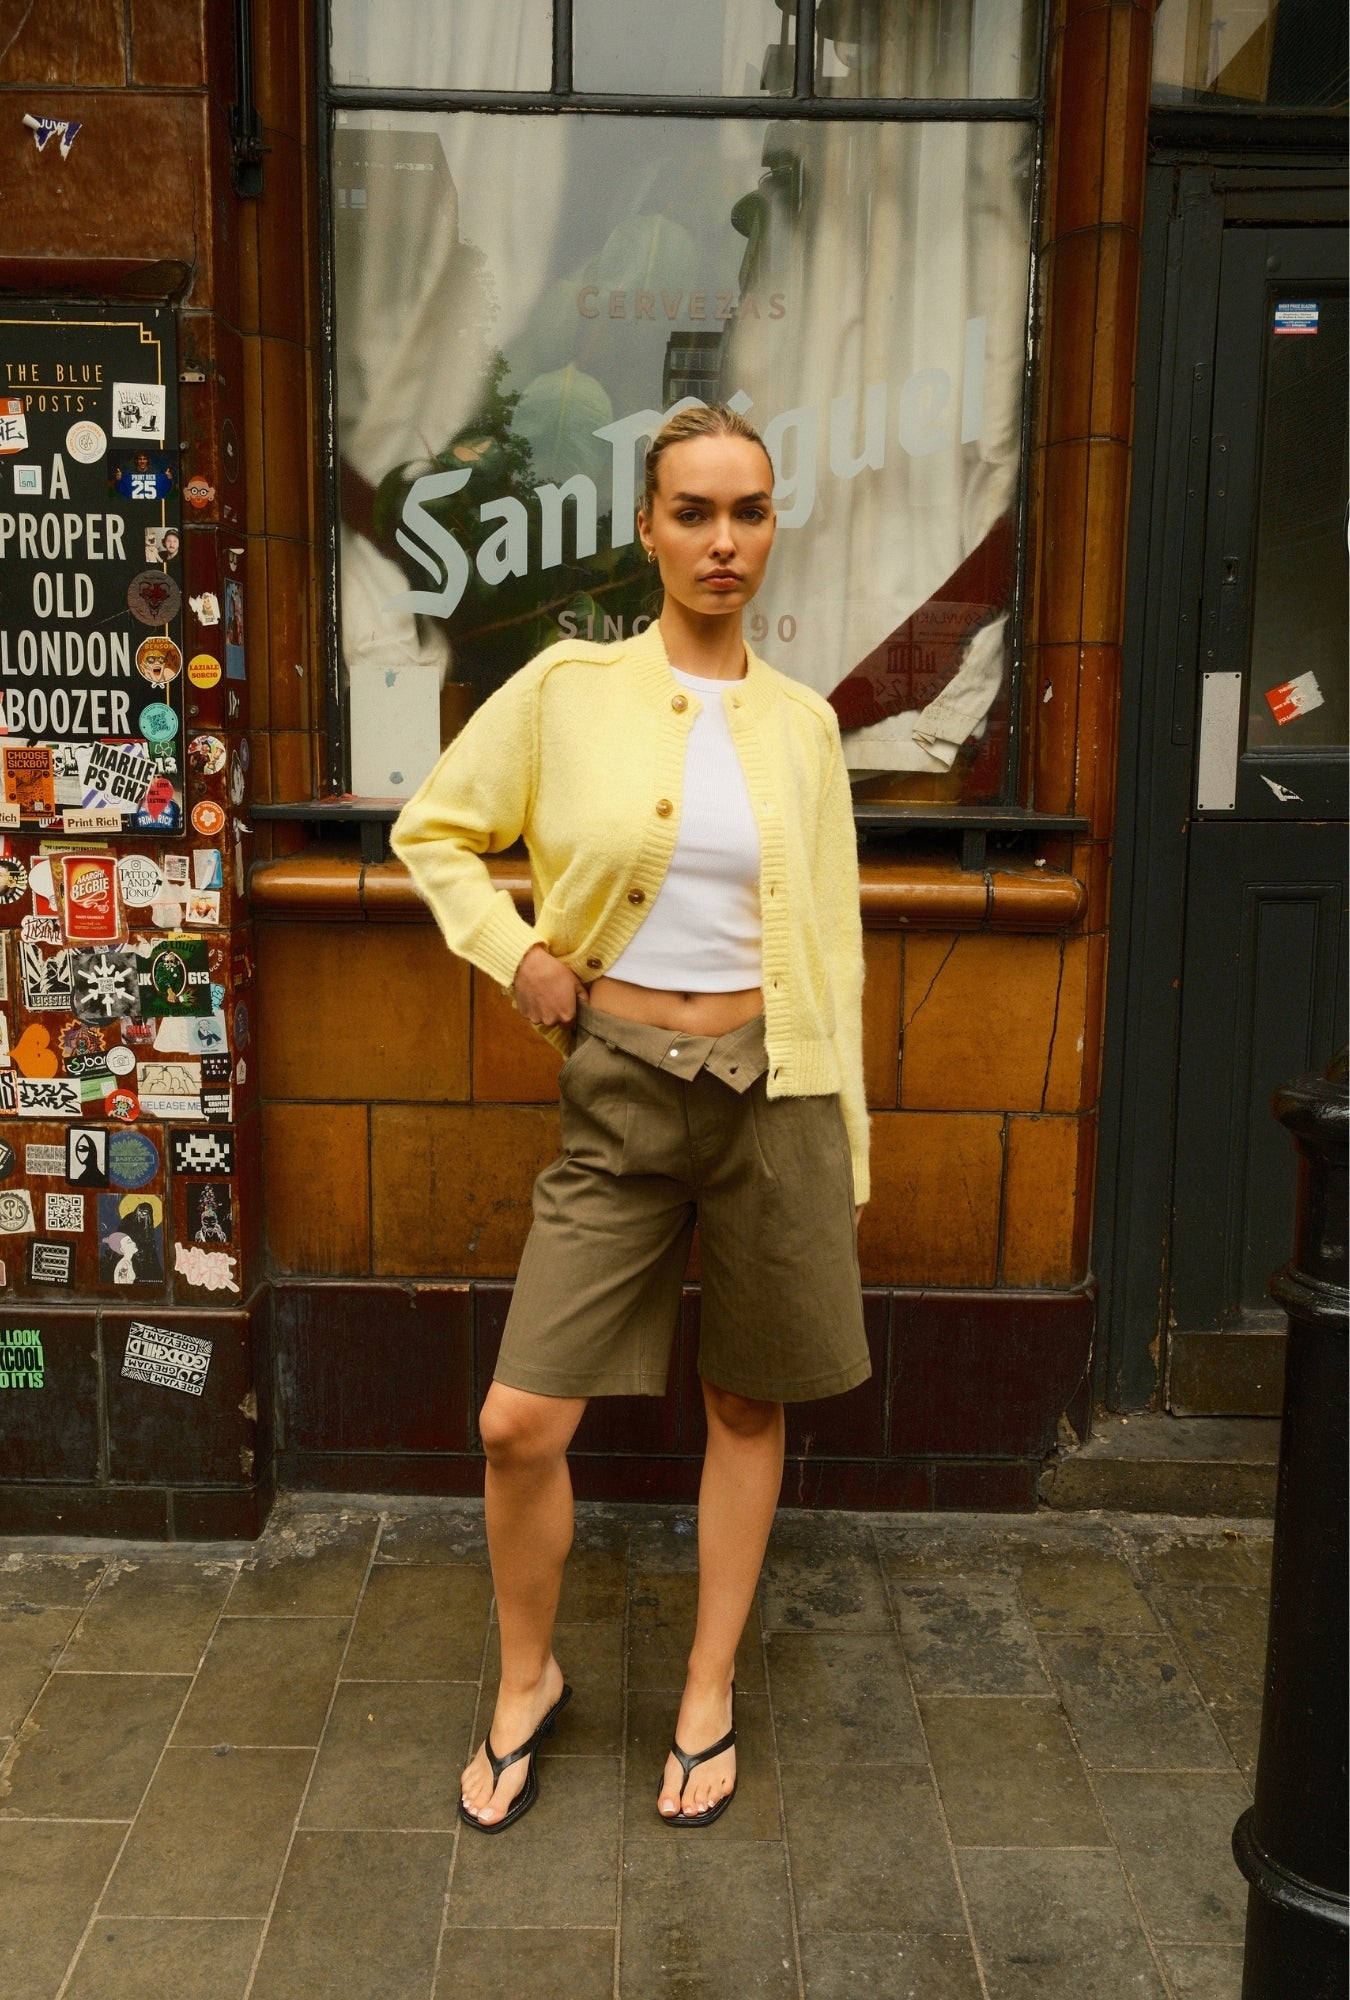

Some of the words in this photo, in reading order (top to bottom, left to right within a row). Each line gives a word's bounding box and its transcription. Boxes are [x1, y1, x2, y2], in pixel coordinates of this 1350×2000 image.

[576, 285, 786, 320] CERVEZAS
[6, 364, 39, 382] THE
[56, 364, 103, 383] BLUE
[26, 395, 84, 412] POSTS
[50, 453, 70, 500] A
[131, 480, 157, 500] 25
[0, 513, 126, 560] PROPER
[383, 467, 598, 619] San
[33, 572, 94, 618] OLD
[557, 610, 652, 640] SINC
[1, 630, 130, 677] LONDON
[6, 688, 131, 734] BOOZER
[7, 751, 48, 760] CHOOSE
[8, 760, 49, 769] SICKBOY
[90, 743, 155, 783] MARLIE
[155, 757, 178, 774] 13
[83, 765, 109, 791] PS
[67, 818, 94, 829] Print
[97, 817, 119, 827] Rich
[118, 869, 158, 881] TATTOO
[128, 879, 151, 887] AND
[71, 878, 109, 901] BEGBIE
[122, 887, 153, 899] TONIC
[141, 1100, 186, 1111] RELEASE
[188, 1102, 202, 1111] ME
[6, 1329, 41, 1346] LOOK
[130, 1340, 206, 1370] GOODCHILD
[11, 1373, 26, 1388] IT
[28, 1373, 44, 1388] IS
